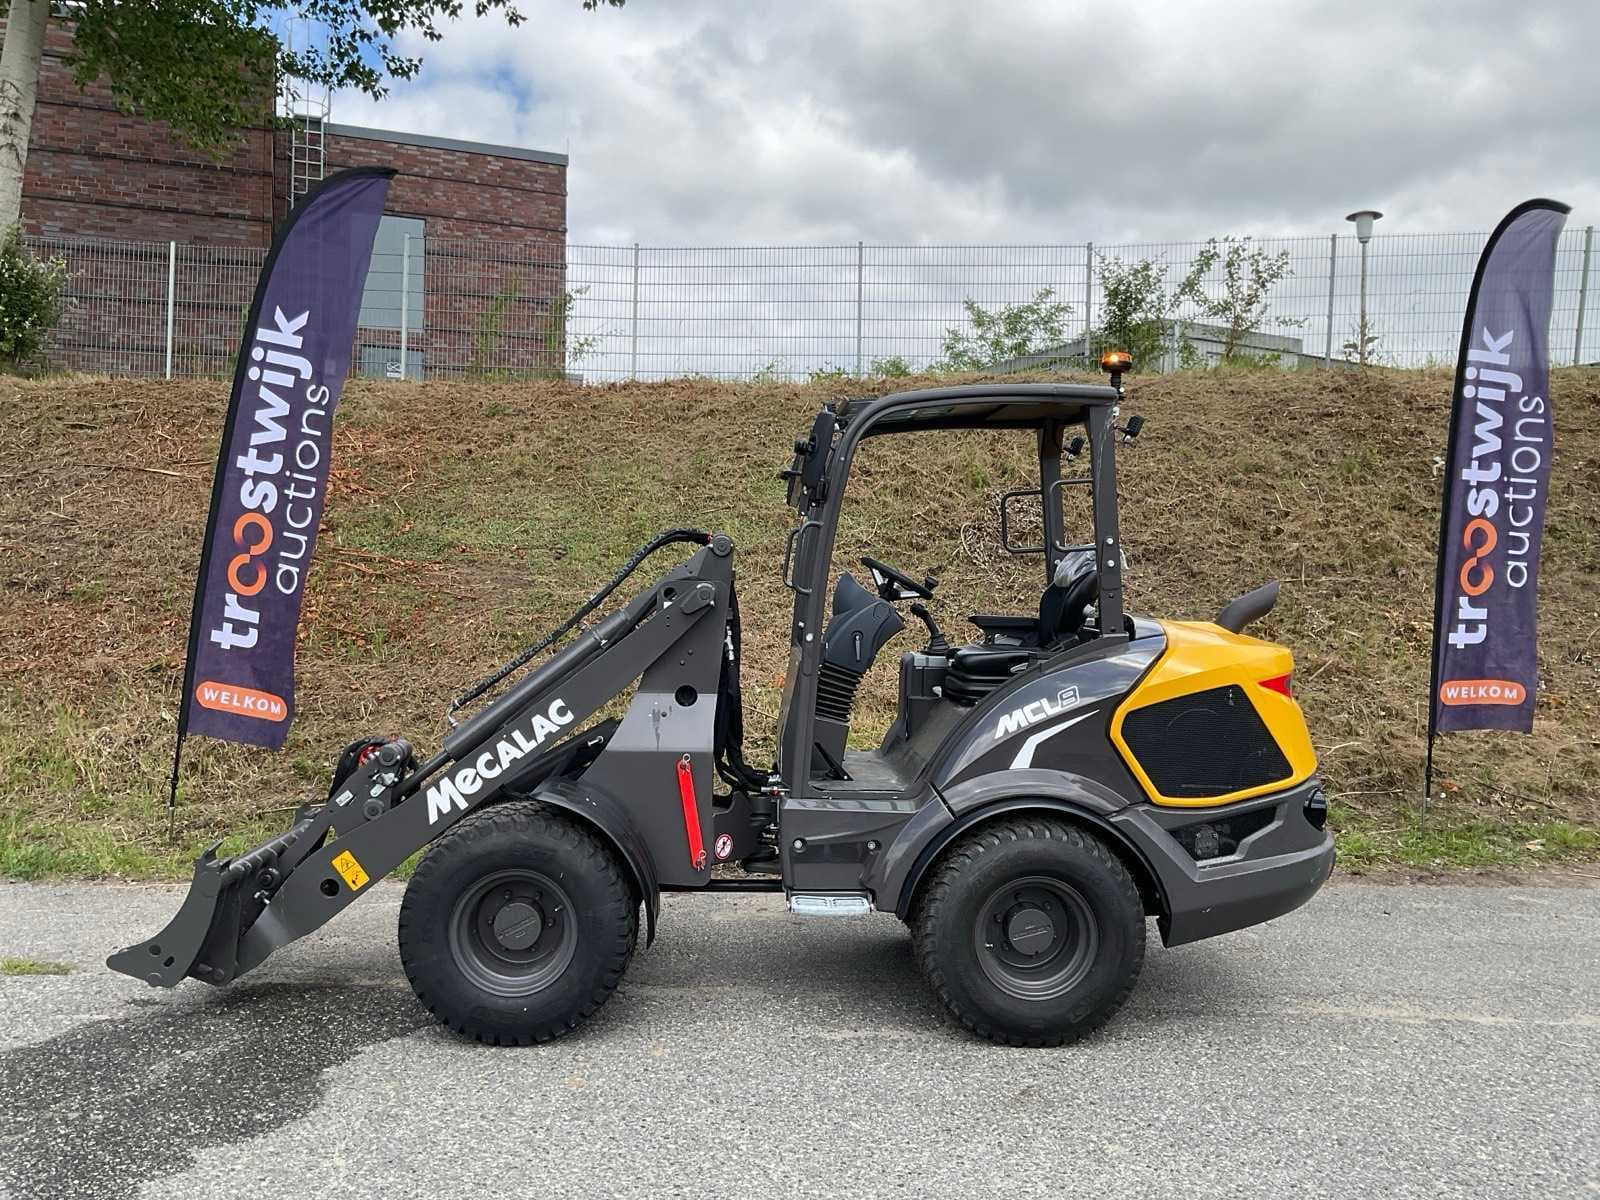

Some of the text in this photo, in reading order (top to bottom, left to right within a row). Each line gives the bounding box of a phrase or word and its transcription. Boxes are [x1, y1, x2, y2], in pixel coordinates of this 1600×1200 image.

[210, 305, 312, 650] troostwijk
[276, 384, 330, 595] auctions
[1448, 327, 1523, 649] troostwijk
[1504, 396, 1545, 588] auctions
[203, 686, 283, 716] WELKOM
[1446, 686, 1518, 700] WELKOM
